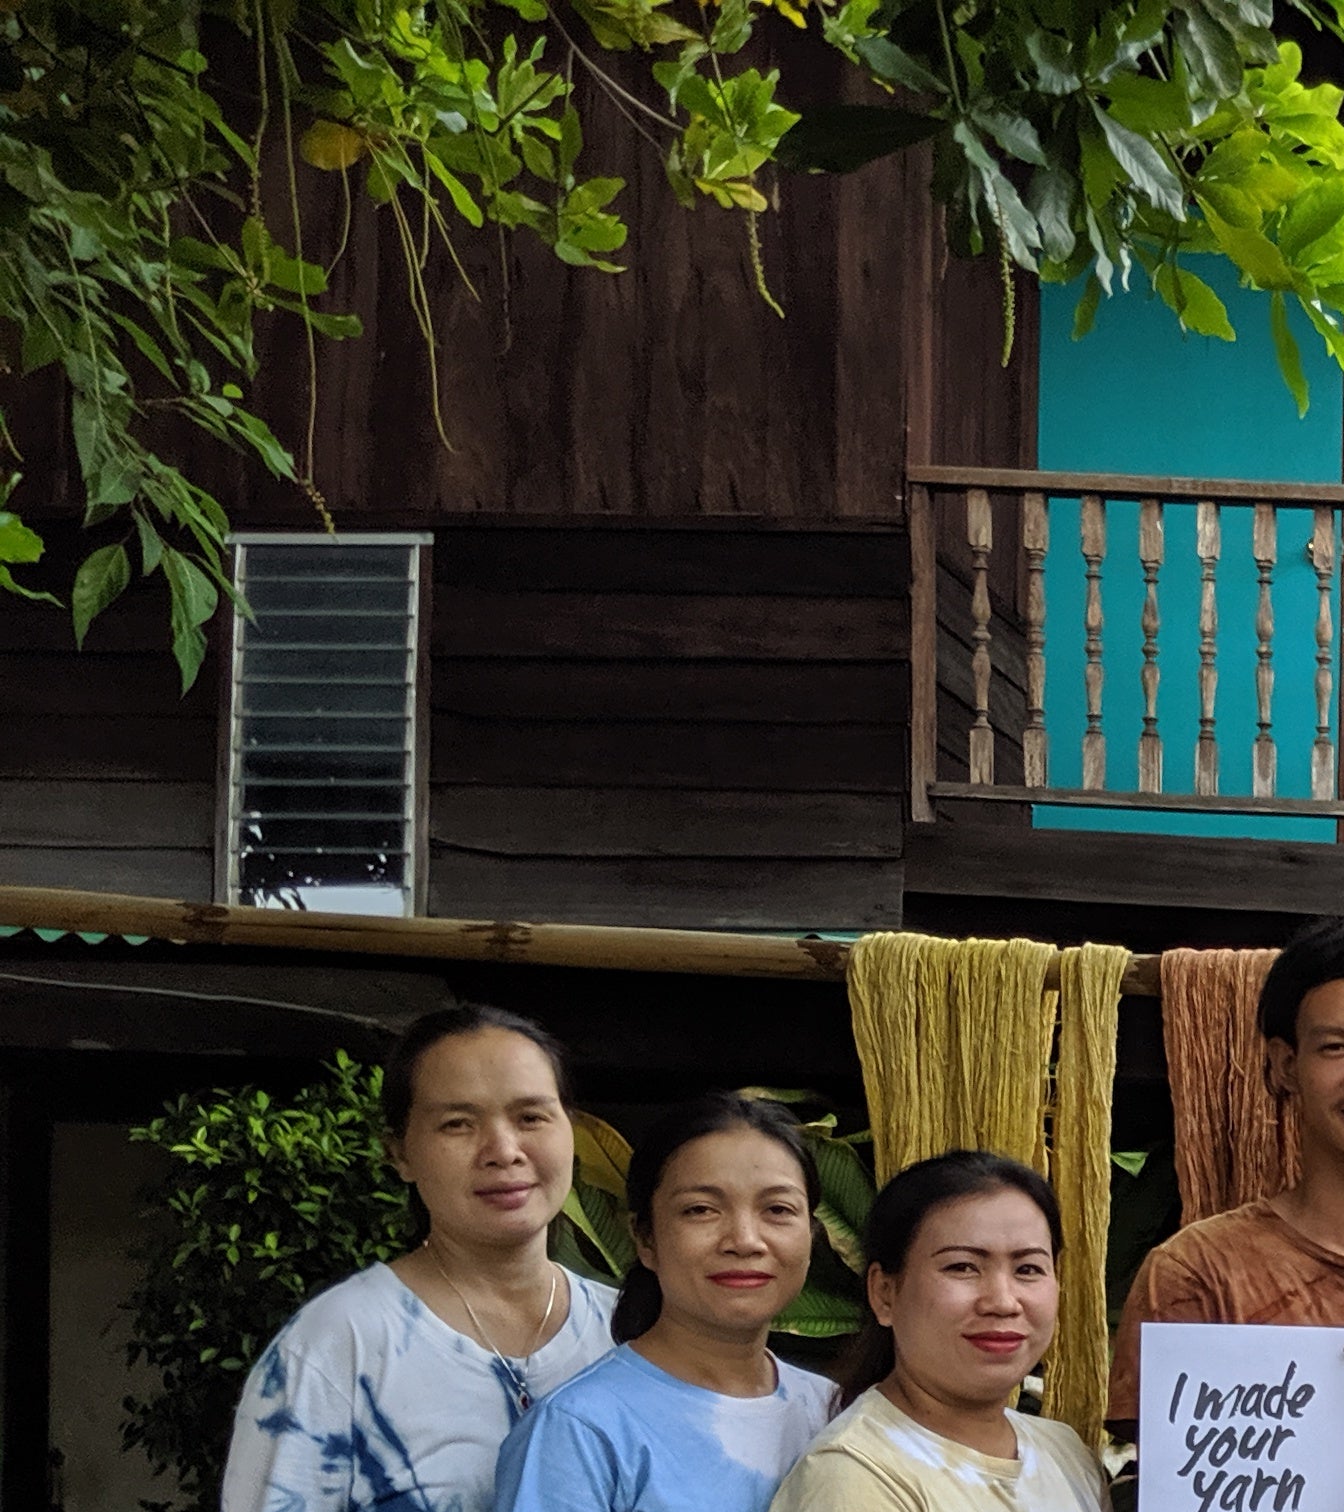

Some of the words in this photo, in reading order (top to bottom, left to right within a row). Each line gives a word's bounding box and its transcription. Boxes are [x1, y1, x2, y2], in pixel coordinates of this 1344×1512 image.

[1169, 1372, 1188, 1424] I
[1194, 1361, 1316, 1421] made
[1177, 1425, 1296, 1478] your
